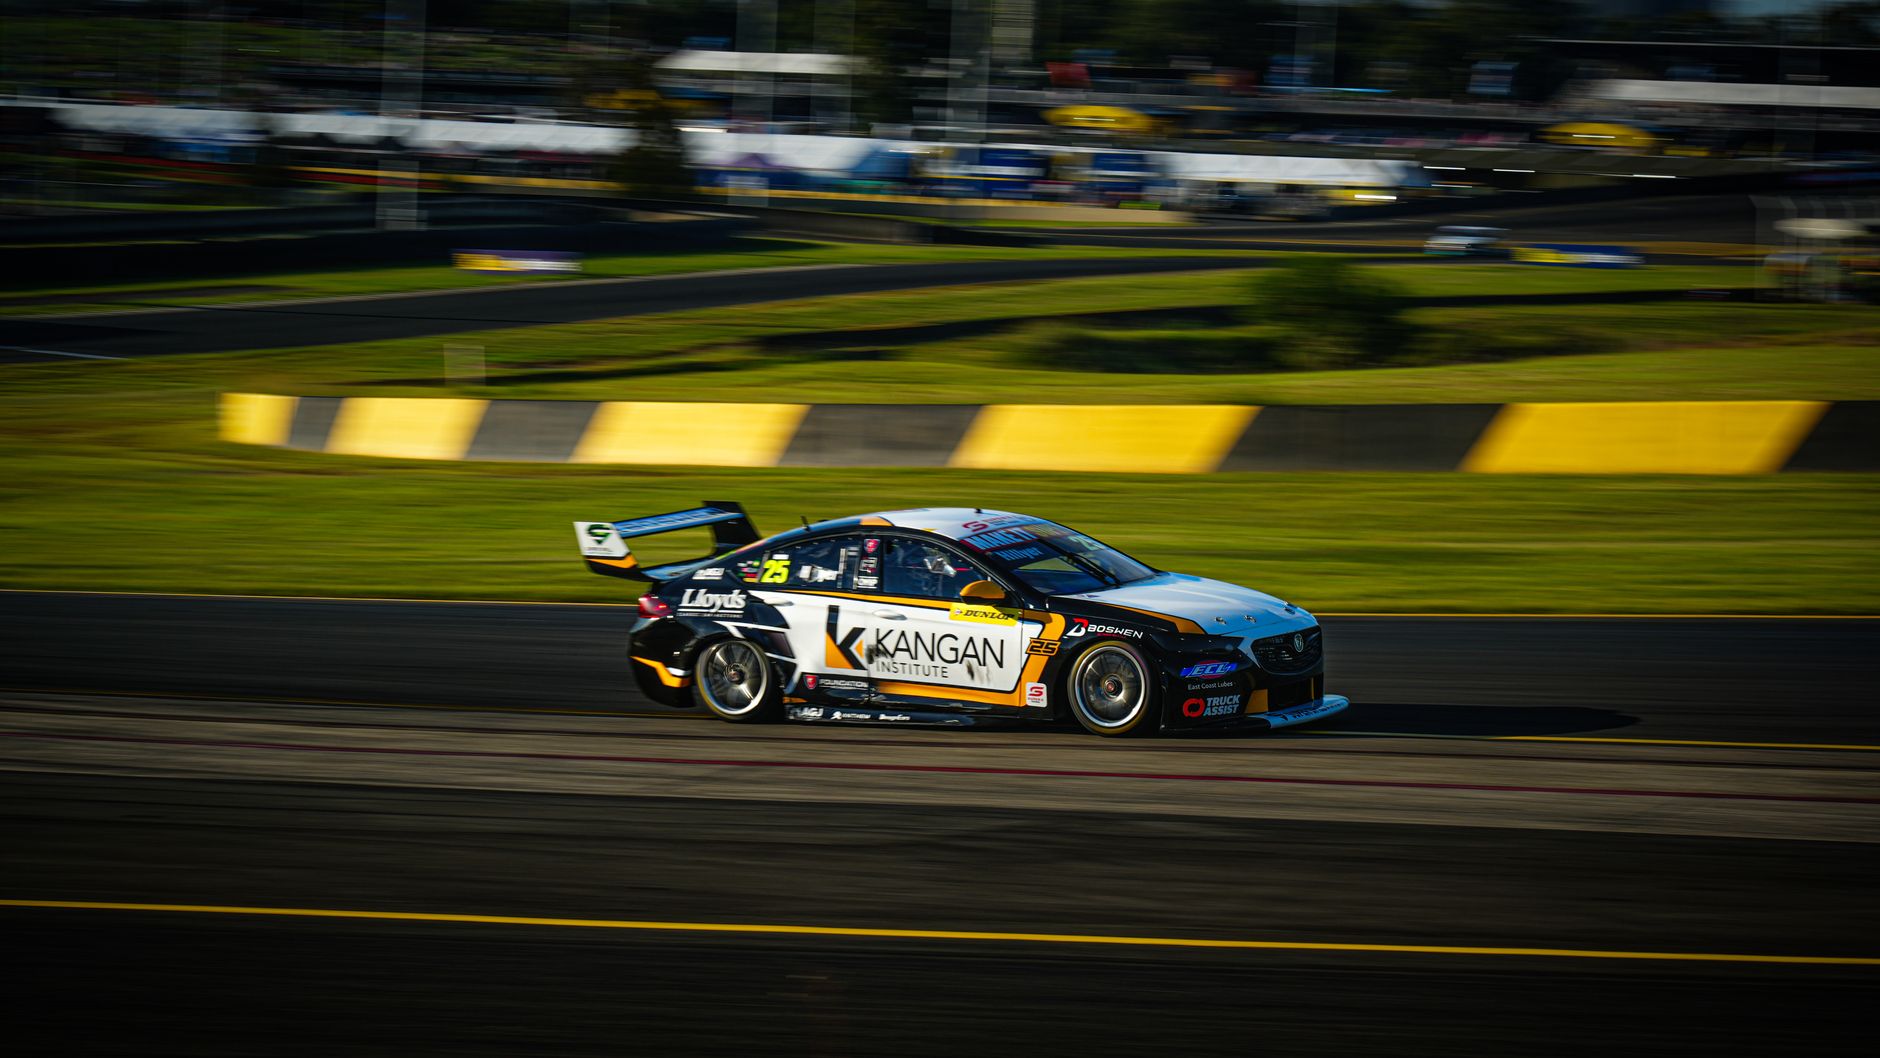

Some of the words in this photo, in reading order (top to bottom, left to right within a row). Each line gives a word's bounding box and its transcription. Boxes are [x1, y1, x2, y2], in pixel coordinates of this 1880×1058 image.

[760, 560, 791, 584] 25
[678, 589, 747, 612] Lloyds
[964, 609, 1016, 621] DUNLOP
[1087, 624, 1144, 639] BOSWEN
[875, 628, 1004, 668] KANGAN
[1027, 639, 1060, 655] 25
[875, 660, 949, 678] INSTITUTE
[1191, 662, 1231, 676] ECL
[1188, 683, 1201, 691] East
[1201, 682, 1217, 690] Coast
[1217, 681, 1234, 689] Lubes
[1206, 694, 1241, 706] TRUCK
[1204, 704, 1239, 716] ASSIST
